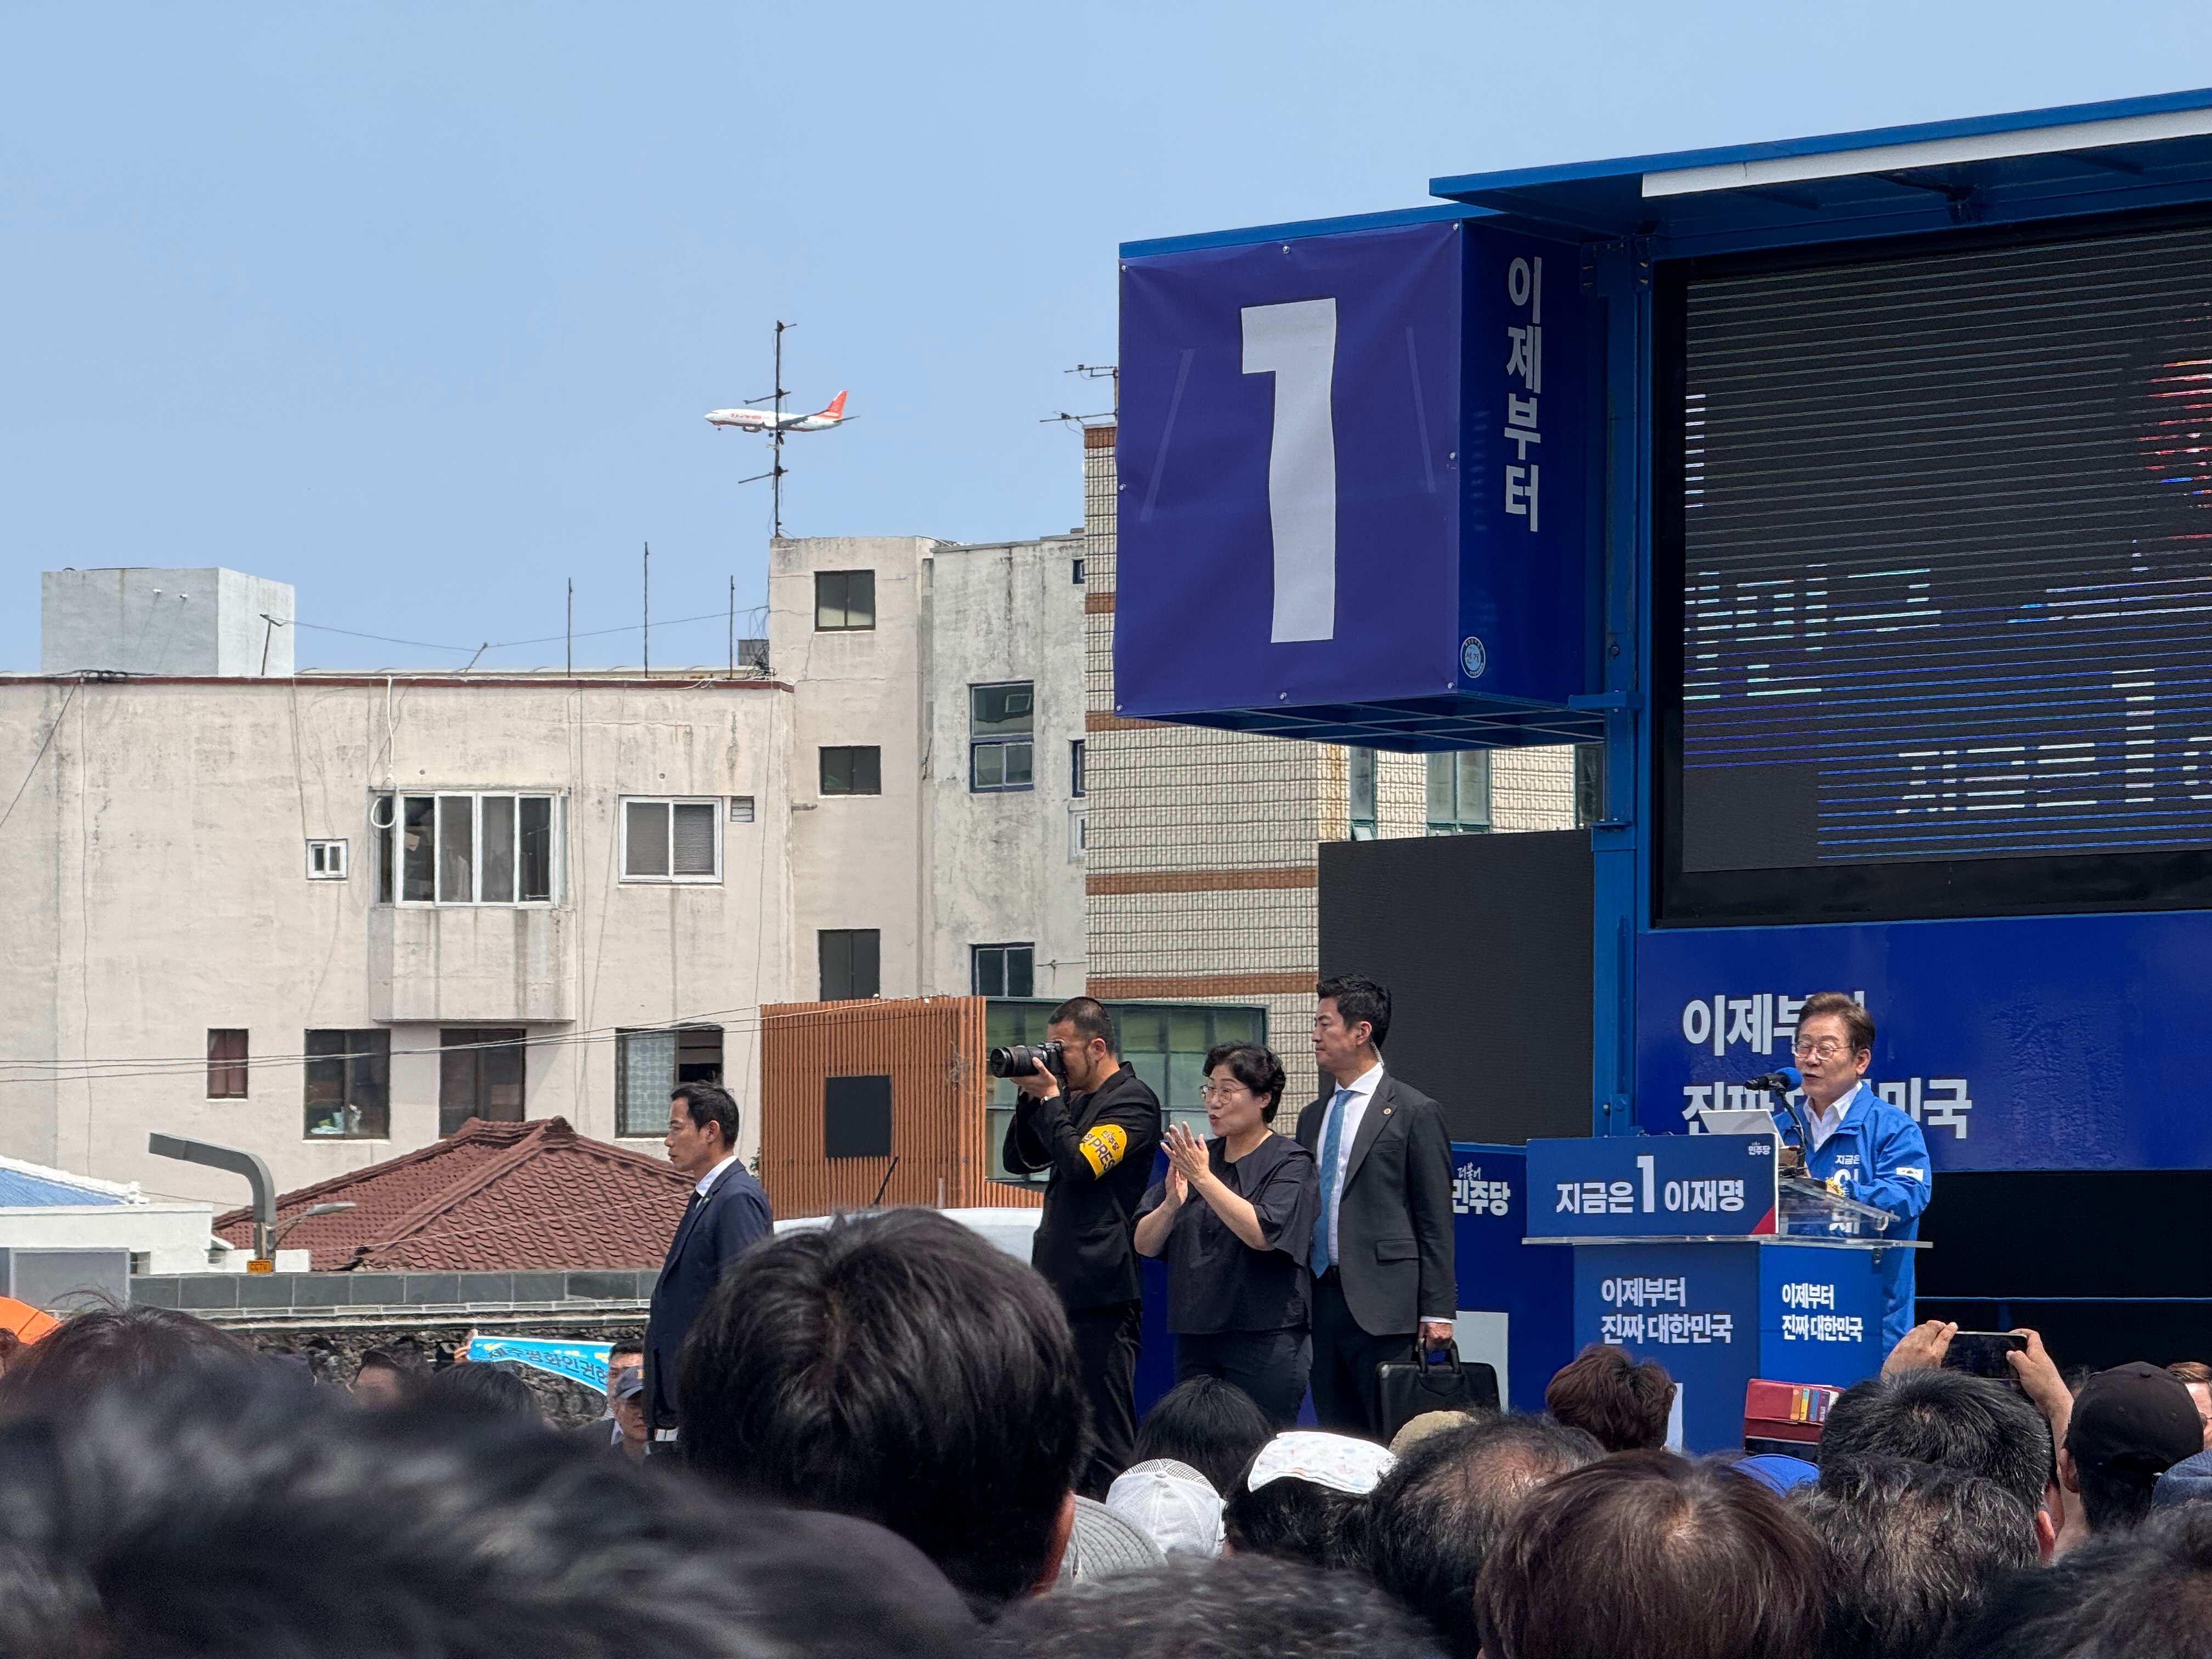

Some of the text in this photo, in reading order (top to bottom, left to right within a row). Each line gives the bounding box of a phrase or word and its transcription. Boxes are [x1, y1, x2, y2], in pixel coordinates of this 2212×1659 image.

[1504, 257, 1542, 532] 이제부터
[1240, 298, 1337, 644] 1
[1748, 1145, 1771, 1155] 민주당
[1835, 1154, 1860, 1165] 지금은
[1452, 1179, 1511, 1216] 민주당
[1556, 1155, 1745, 1214] 지금은 1 이재명
[1601, 1277, 1686, 1307] 이제부터
[1782, 1283, 1835, 1311] 이제부터
[1600, 1313, 1734, 1344] 진짜 대한민국
[1782, 1314, 1864, 1342] 진짜 대한민국
